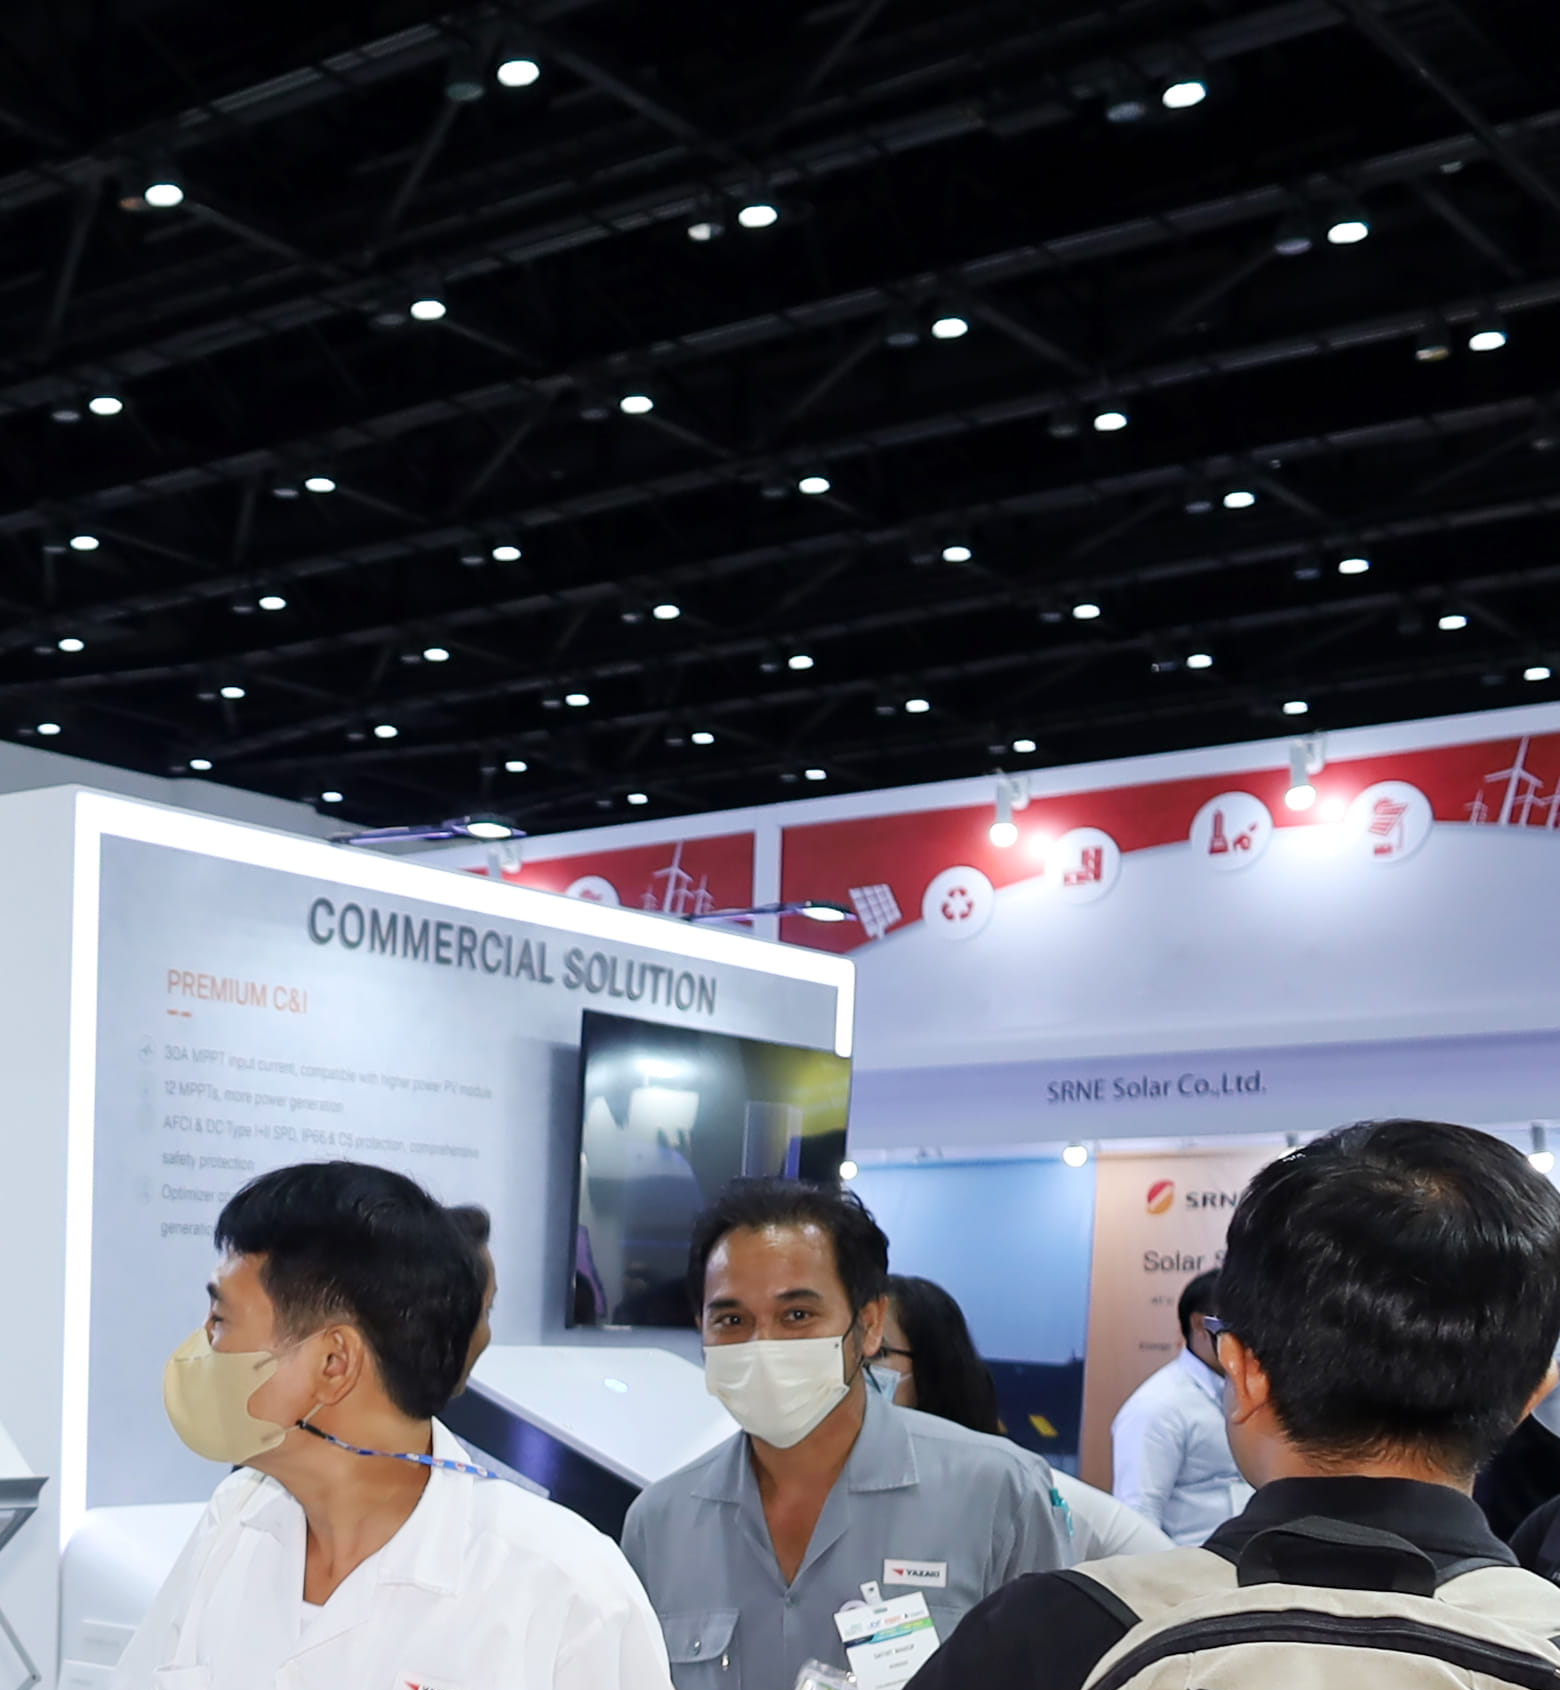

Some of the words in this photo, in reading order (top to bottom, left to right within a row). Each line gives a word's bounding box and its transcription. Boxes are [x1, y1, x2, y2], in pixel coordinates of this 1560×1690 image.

[308, 897, 554, 985] COMMERCIAL
[565, 946, 717, 1016] SOLUTION
[166, 968, 268, 1008] PREMIUM
[273, 985, 308, 1013] C&I
[1047, 1080, 1106, 1102] SRNE
[1113, 1075, 1172, 1100] Solar
[1143, 1251, 1204, 1273] Solar
[906, 1568, 941, 1578] YAZAKI
